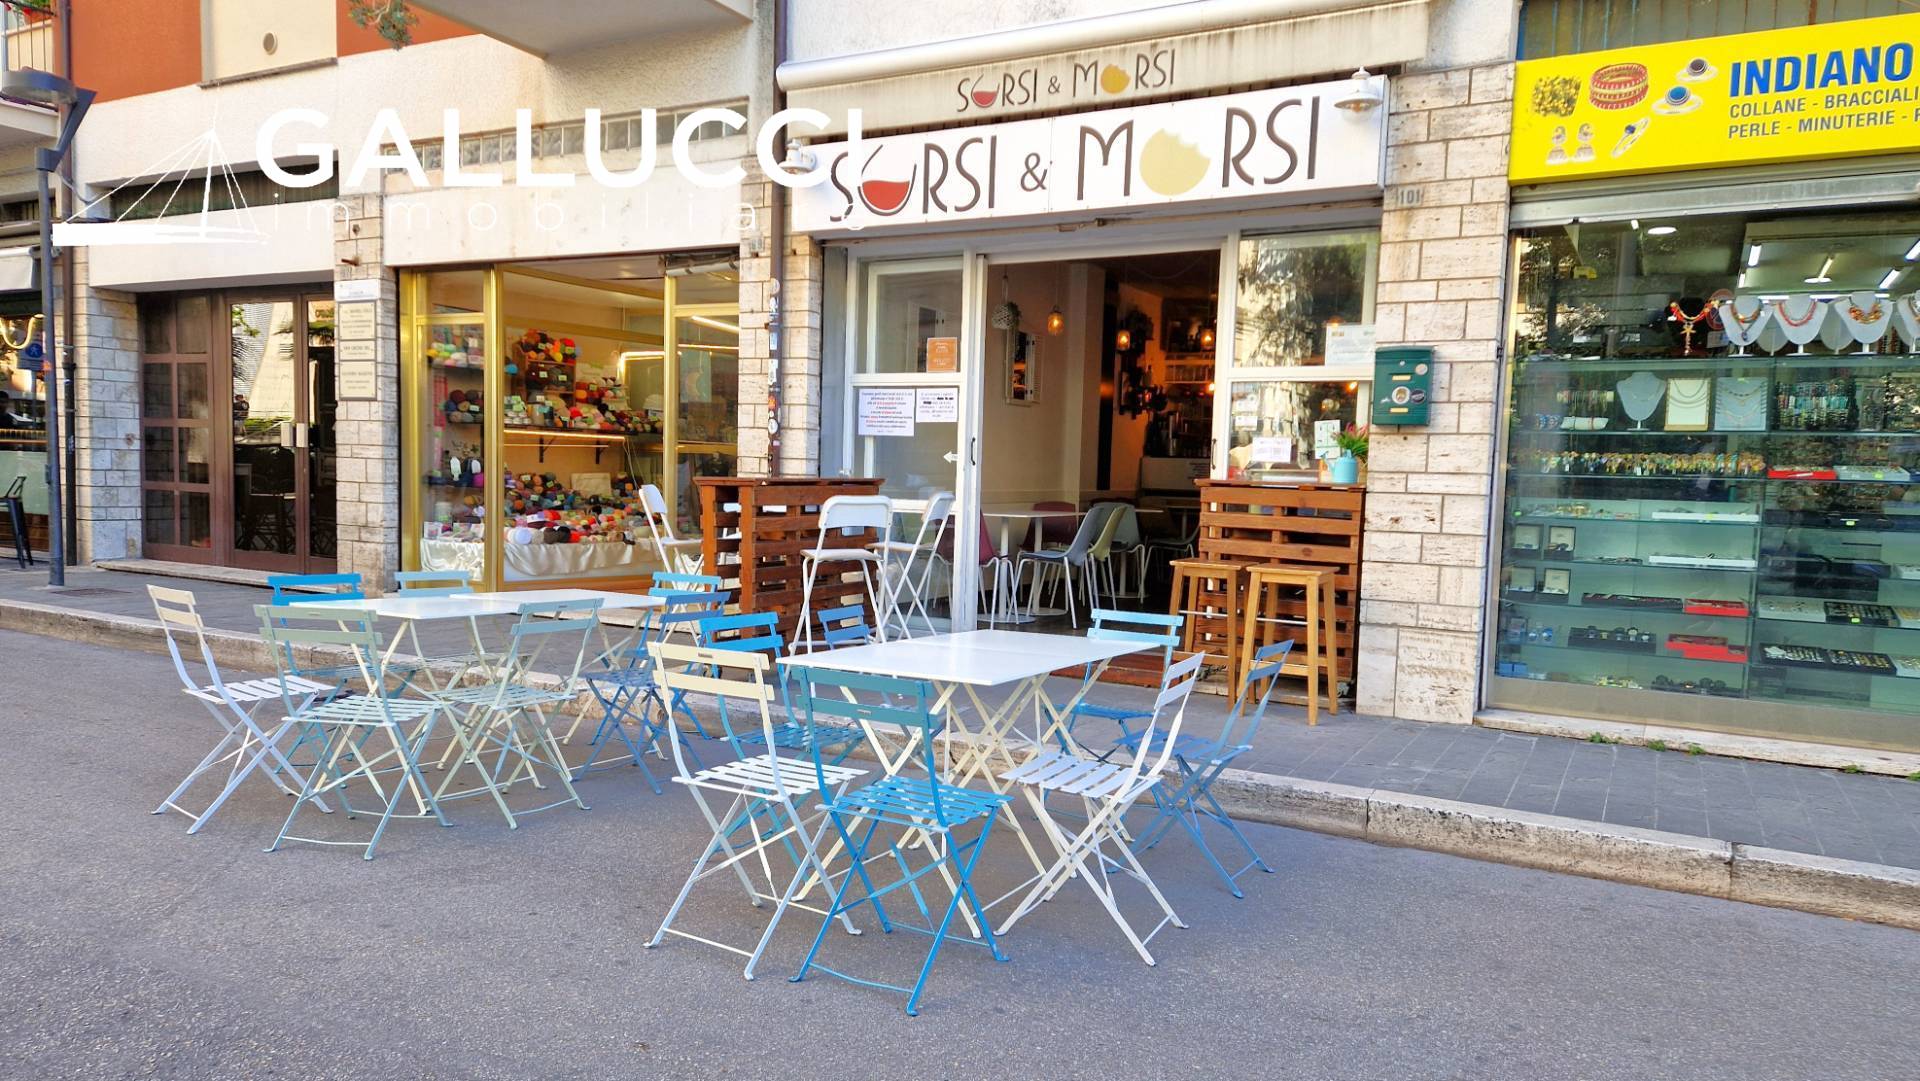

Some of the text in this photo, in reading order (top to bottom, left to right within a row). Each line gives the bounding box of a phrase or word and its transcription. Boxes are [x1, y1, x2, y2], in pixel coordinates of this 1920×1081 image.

[958, 50, 1175, 112] SORSI & MORSI
[1730, 43, 1914, 97] INDIANO
[1729, 98, 1806, 118] COLLANE
[1824, 86, 1919, 109] BRACCIALI
[1728, 121, 1780, 139] PERLE
[1798, 110, 1895, 133] MINUTERIE
[1021, 153, 1048, 192] &
[1077, 97, 1320, 201] MORSI
[1400, 189, 1420, 205] 101
